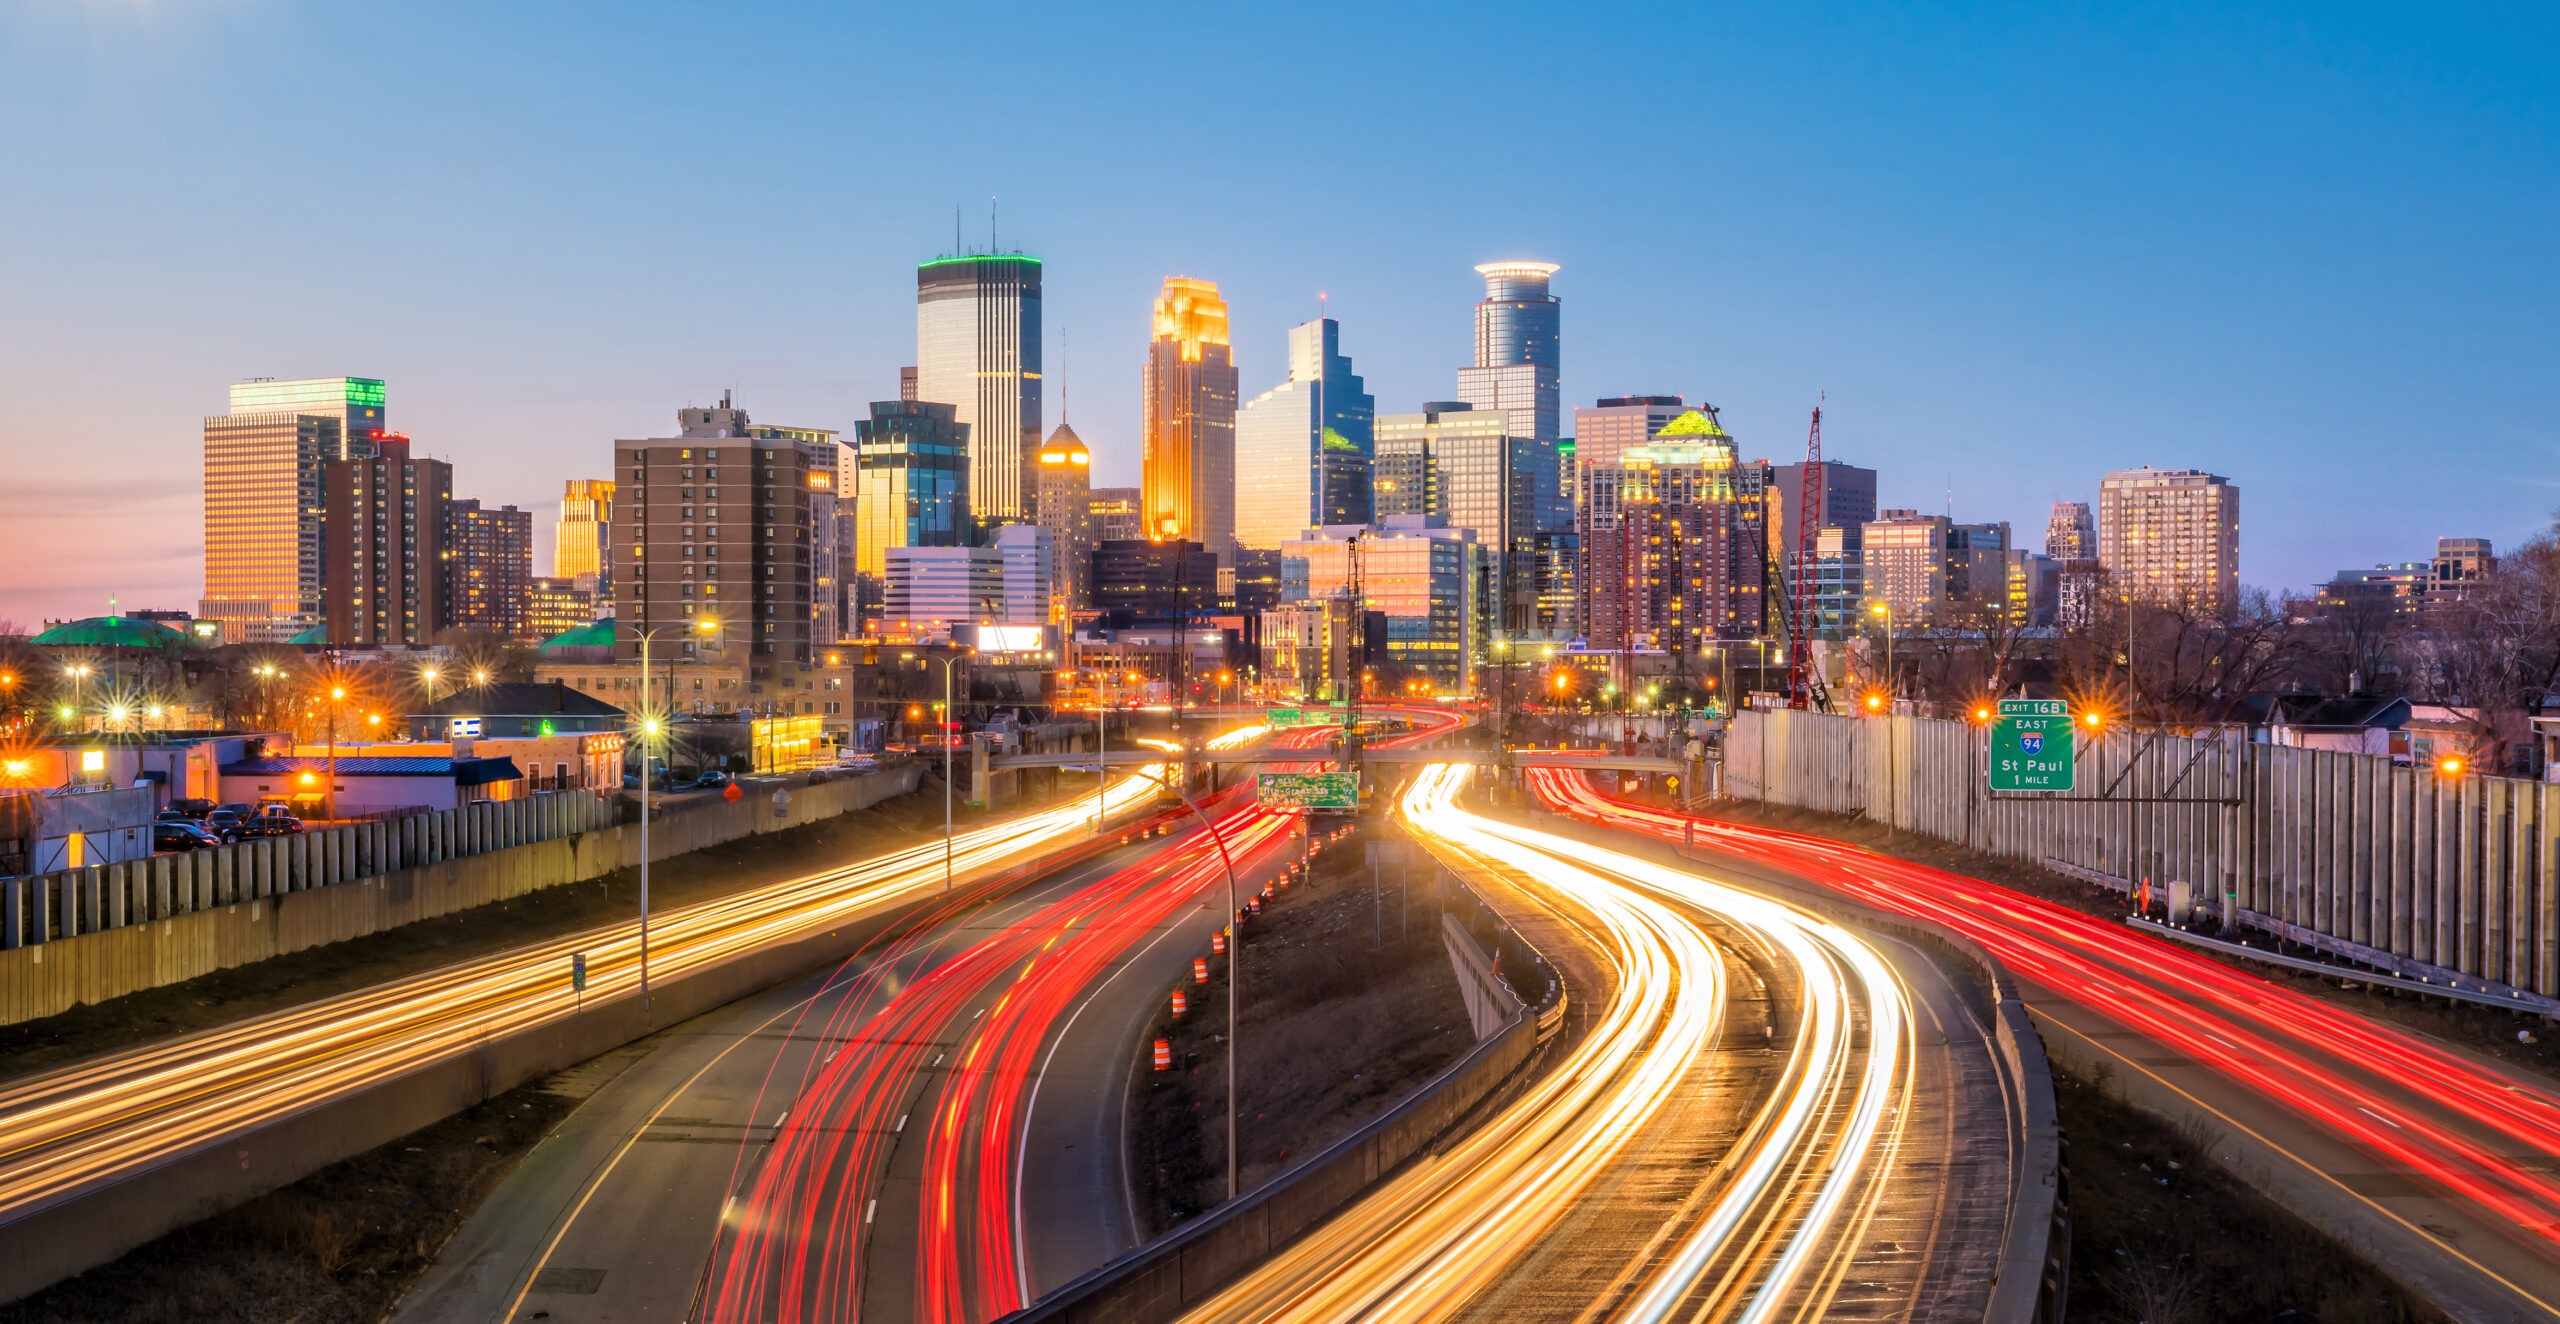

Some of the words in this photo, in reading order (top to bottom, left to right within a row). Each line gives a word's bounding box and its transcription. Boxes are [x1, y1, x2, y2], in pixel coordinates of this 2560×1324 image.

[2005, 704, 2028, 712] EXIT
[2034, 702, 2060, 713] 16B
[2016, 720, 2048, 729] EAST
[2024, 738, 2041, 750] 94
[2002, 760, 2018, 771] St
[2027, 760, 2063, 771] Paul
[2015, 775, 2019, 785] 1
[2025, 776, 2049, 784] MILE
